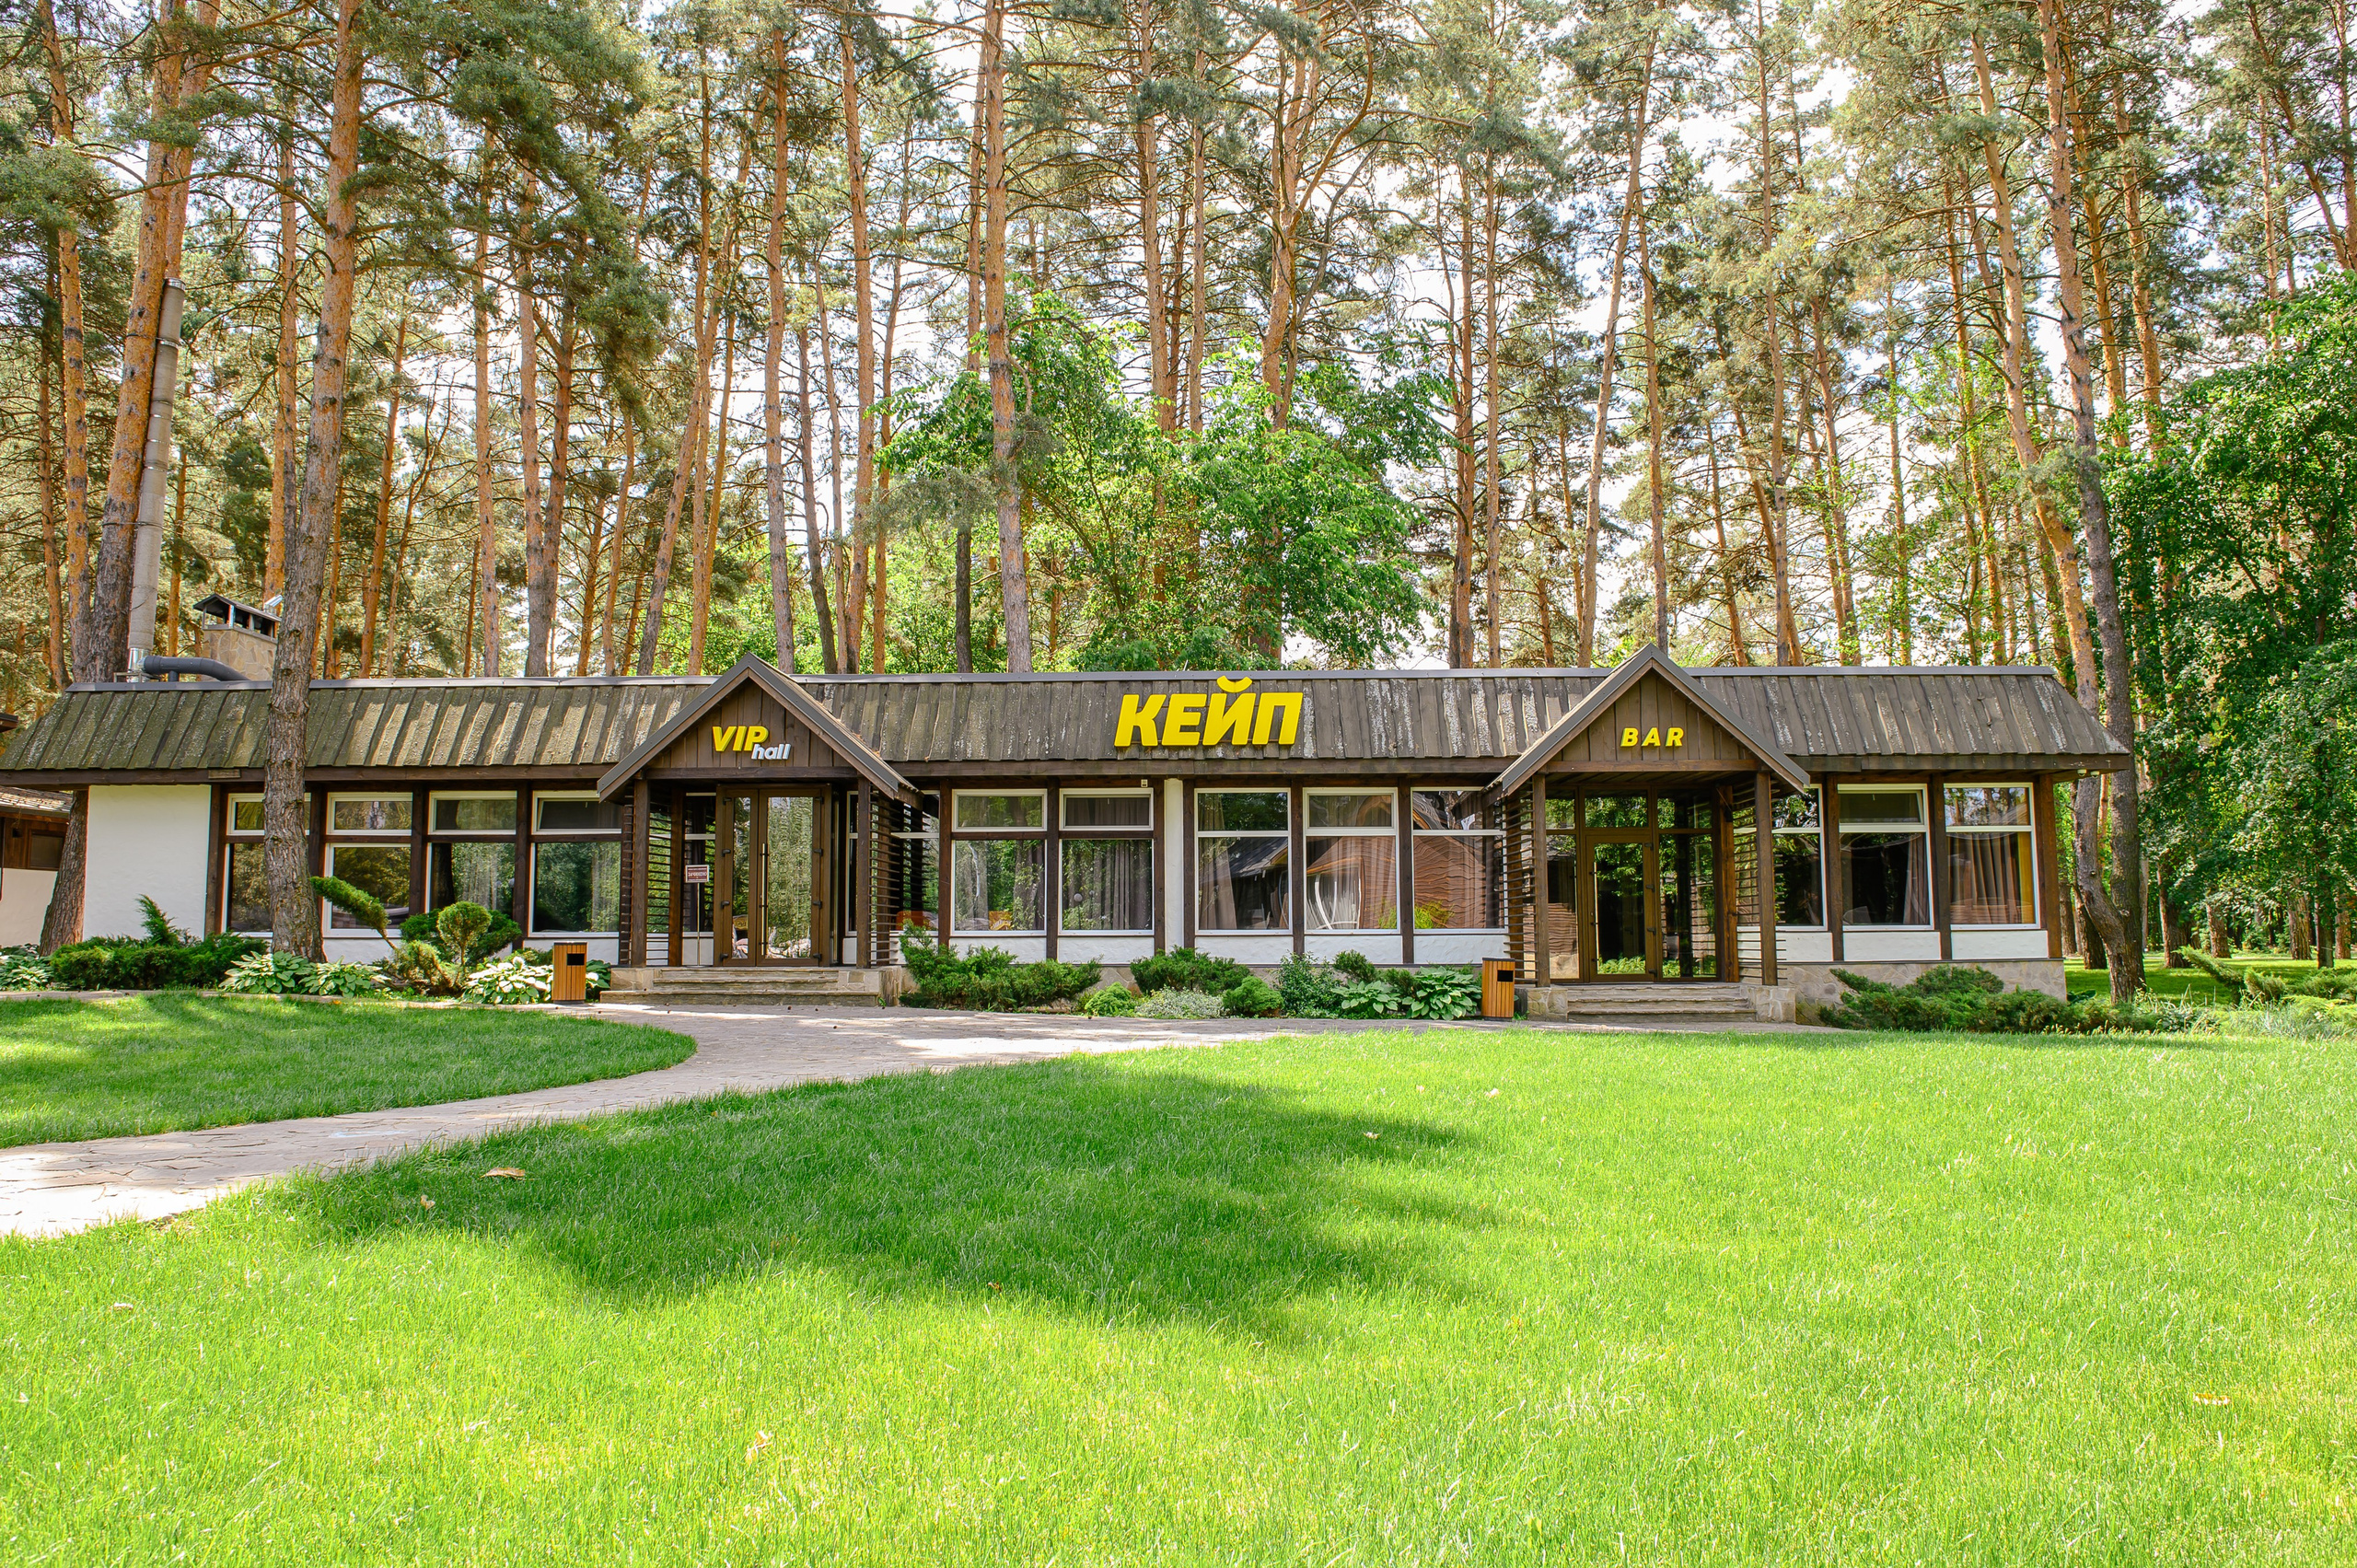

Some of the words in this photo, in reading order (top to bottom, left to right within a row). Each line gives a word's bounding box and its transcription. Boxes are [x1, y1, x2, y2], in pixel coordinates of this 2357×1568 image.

[1114, 677, 1304, 747] КЕЙП
[713, 726, 769, 751] VIP
[1620, 727, 1684, 747] BAR
[751, 743, 791, 760] hall
